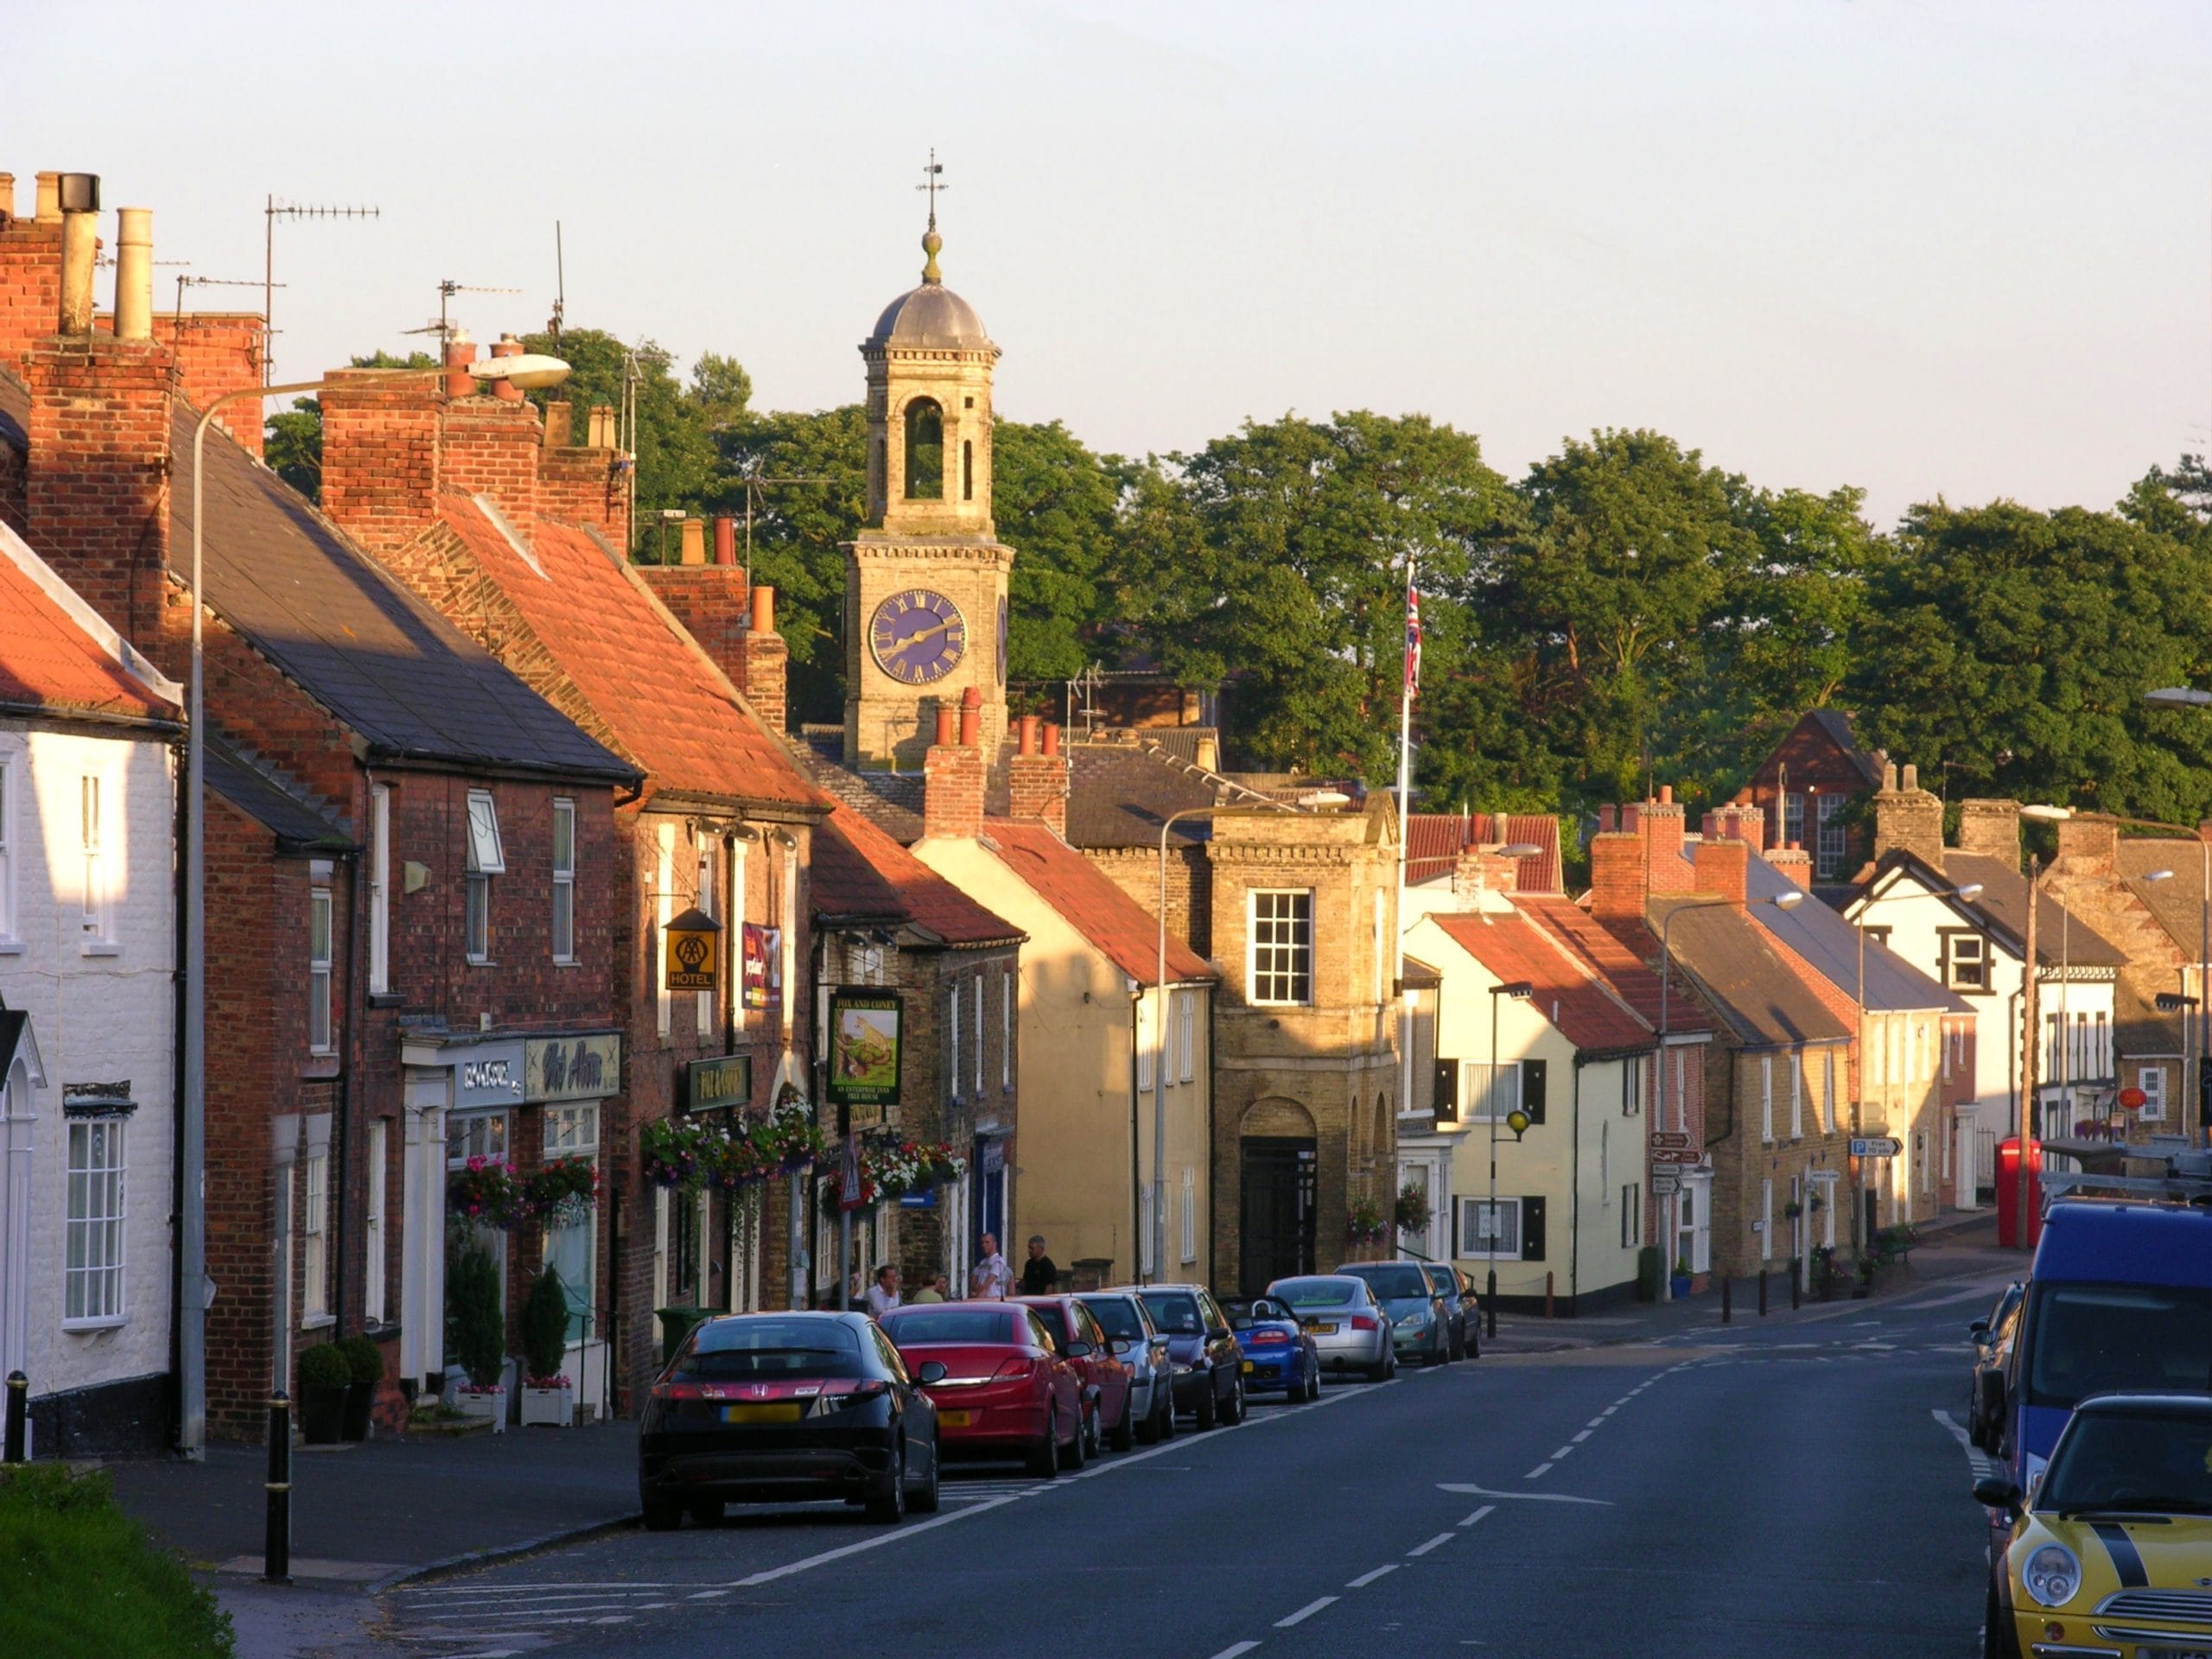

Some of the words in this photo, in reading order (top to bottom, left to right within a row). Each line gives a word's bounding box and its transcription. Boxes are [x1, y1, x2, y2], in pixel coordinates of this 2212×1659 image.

[671, 973, 711, 984] HOTEL
[836, 998, 852, 1007] FOX
[854, 999, 869, 1008] AND
[871, 999, 896, 1010] CONEY
